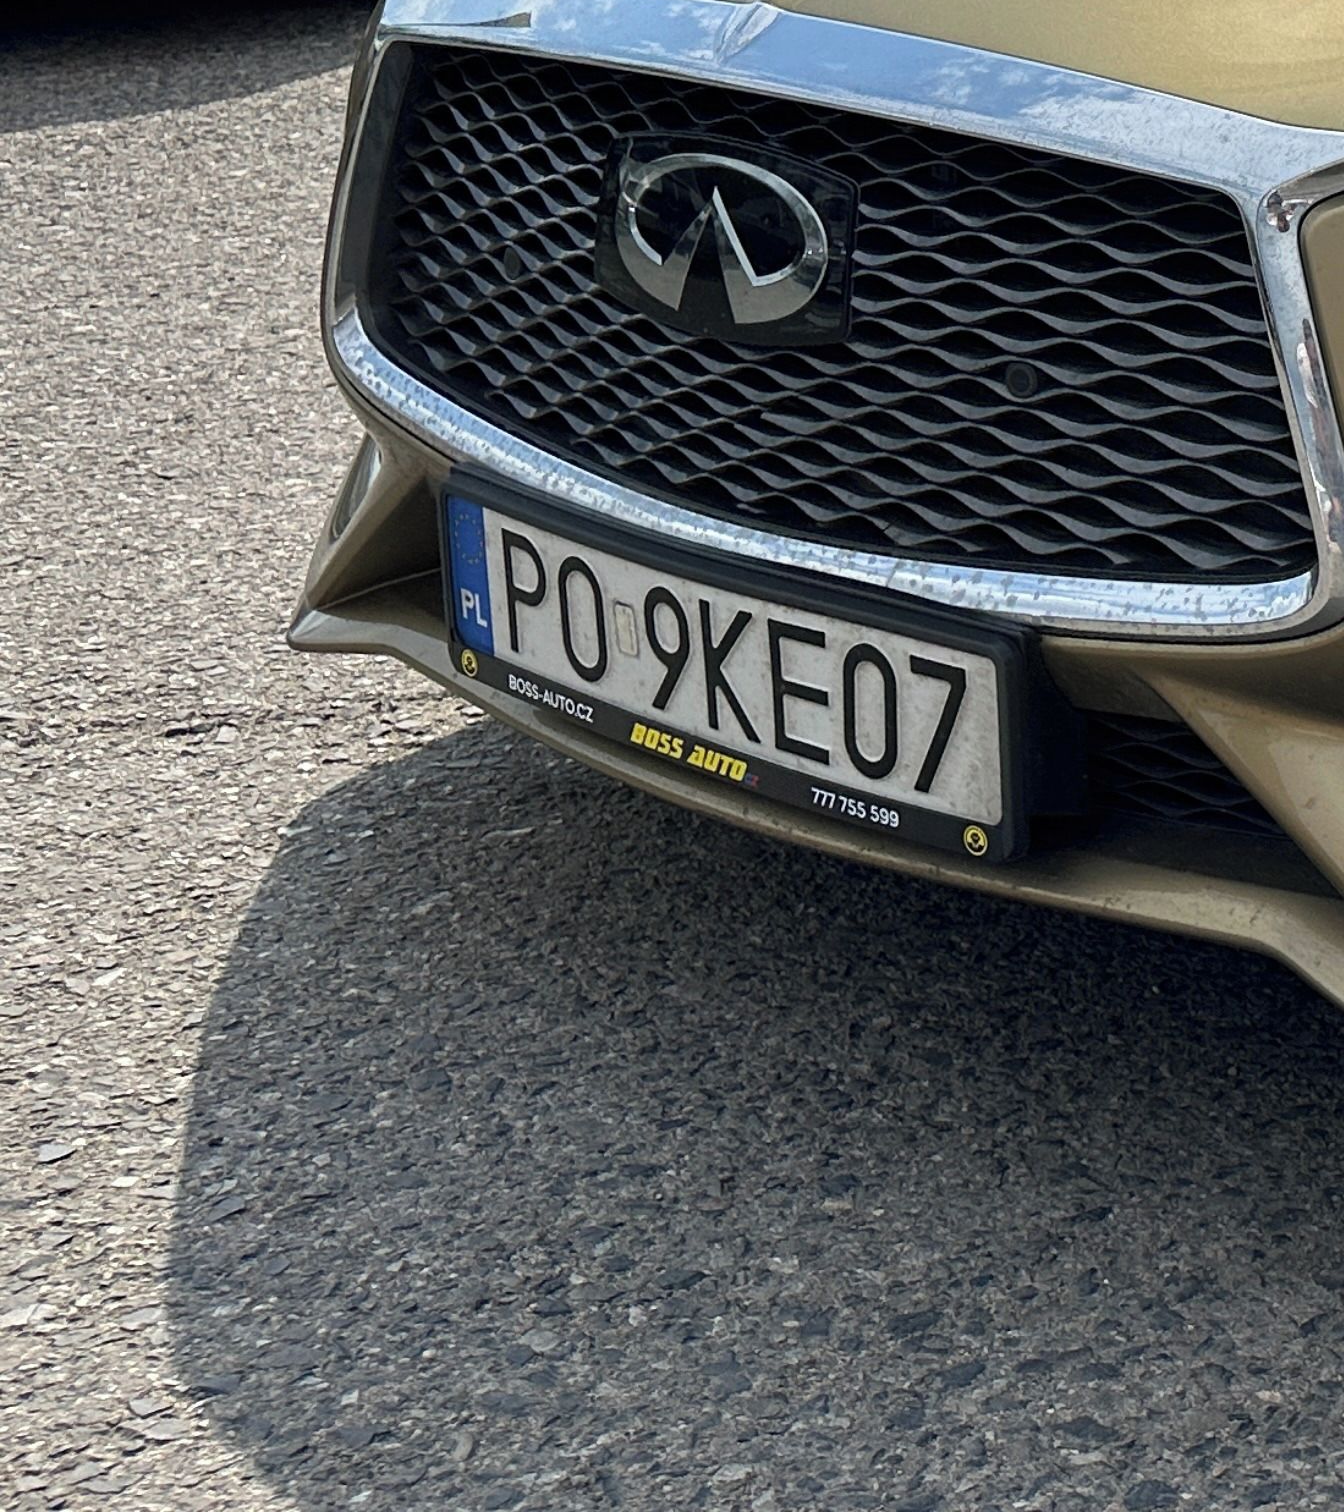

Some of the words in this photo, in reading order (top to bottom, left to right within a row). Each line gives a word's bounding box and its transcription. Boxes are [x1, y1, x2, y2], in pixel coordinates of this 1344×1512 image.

[460, 587, 488, 628] PL
[501, 527, 608, 683] PO
[643, 585, 967, 794] 9KE07
[508, 673, 595, 724] BOSS-AUTO.CZ
[630, 722, 685, 759] BOSS
[686, 744, 748, 782] AUTO
[811, 786, 836, 809] 777
[838, 795, 867, 820] 755
[869, 805, 900, 828] 599
